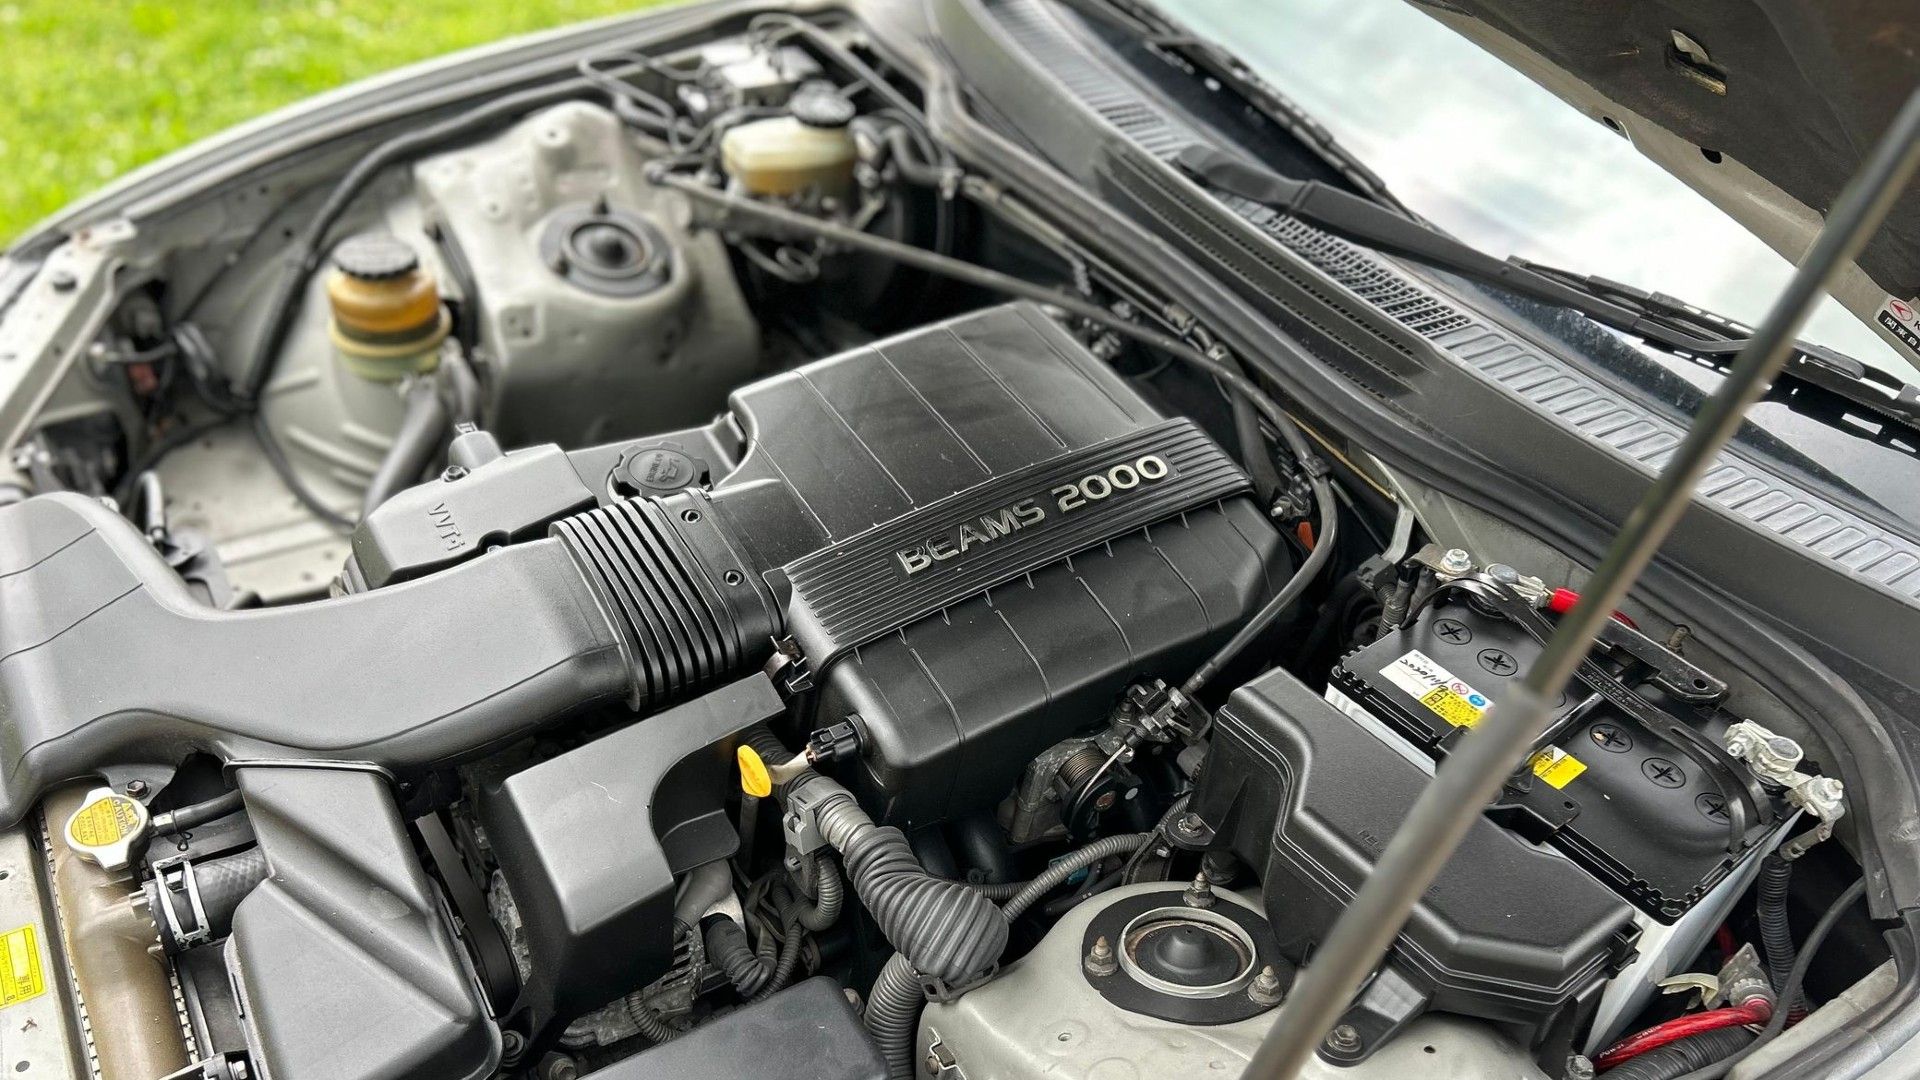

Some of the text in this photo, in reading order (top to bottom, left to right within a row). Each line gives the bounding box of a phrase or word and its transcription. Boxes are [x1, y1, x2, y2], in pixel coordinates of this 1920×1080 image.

[897, 454, 1169, 575] BEAMS 2000
[113, 799, 130, 836] CAUTION
